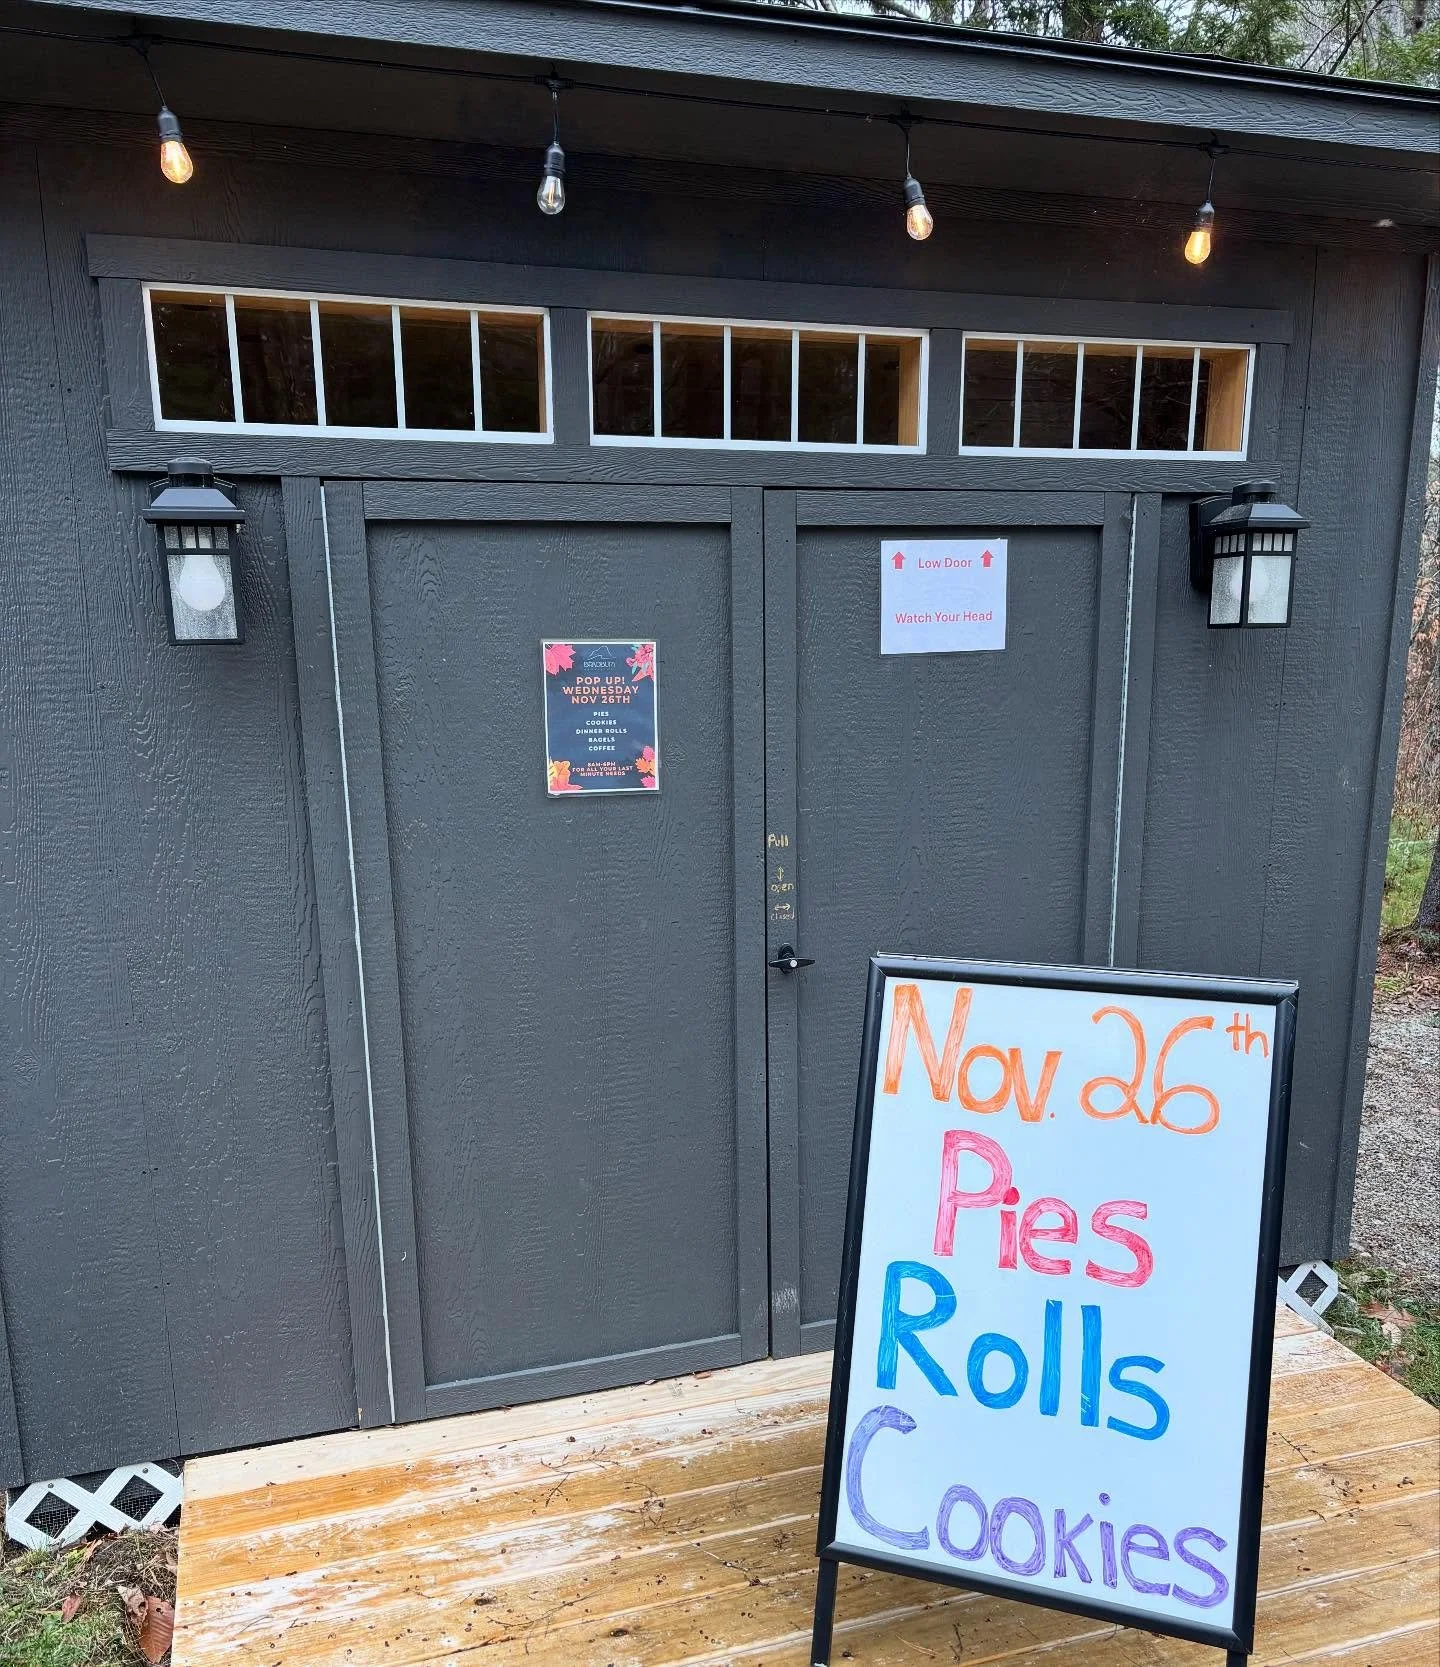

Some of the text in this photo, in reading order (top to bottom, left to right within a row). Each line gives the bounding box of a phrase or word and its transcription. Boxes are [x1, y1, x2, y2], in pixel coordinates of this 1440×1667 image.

[918, 557, 972, 569] Low Door
[895, 610, 993, 624] Watch Your Head
[576, 676, 625, 685] POP UP!
[562, 685, 639, 695] WEDNESDAY
[571, 695, 631, 704] NOV 26TH
[883, 983, 1063, 1123] Nov.
[933, 1129, 1154, 1289] Pies
[876, 1260, 1170, 1441] Rolls
[846, 1404, 1230, 1609] Cookies
